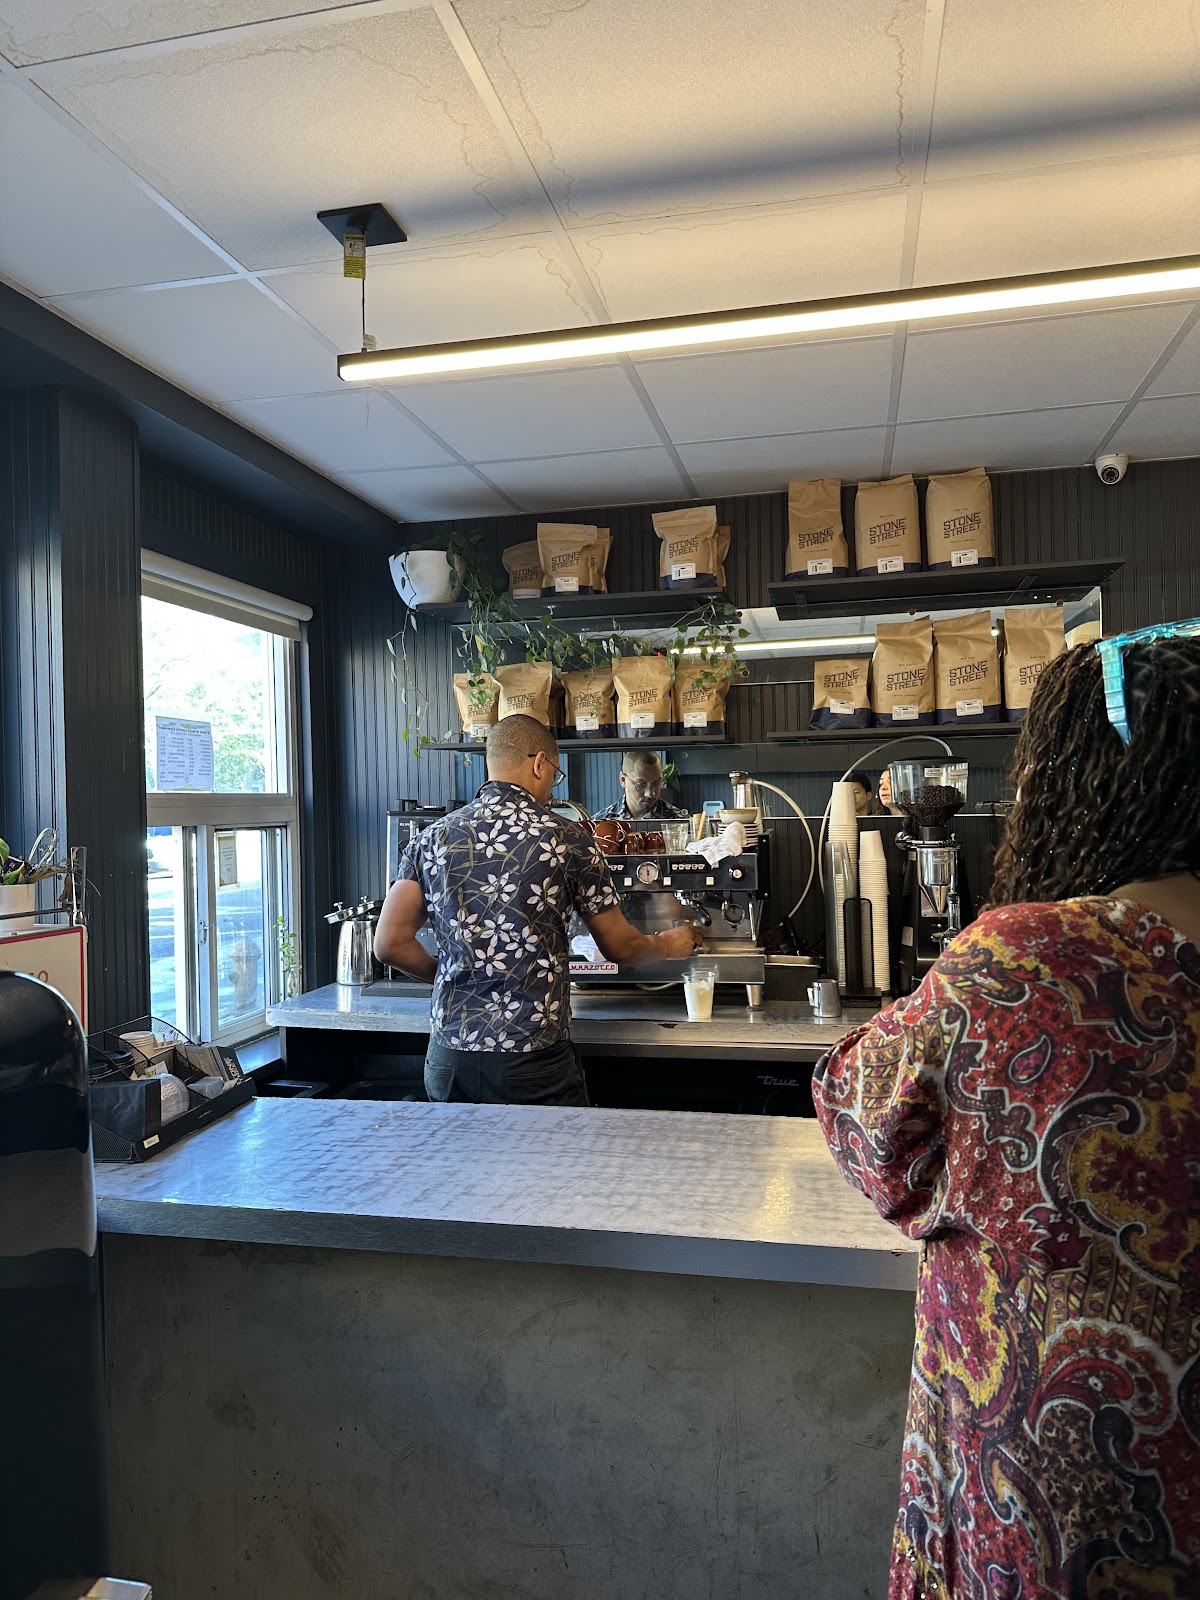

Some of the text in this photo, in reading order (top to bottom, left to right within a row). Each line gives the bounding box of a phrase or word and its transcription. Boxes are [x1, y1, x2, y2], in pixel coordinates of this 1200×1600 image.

[869, 517, 907, 537] STONE
[943, 511, 982, 531] STONE
[798, 526, 834, 542] STONE
[869, 527, 907, 545] STREET
[943, 521, 982, 539] STREET
[668, 536, 699, 552] STONE
[798, 534, 834, 549] STREET
[551, 551, 580, 565] STONE
[668, 544, 699, 559] STREET
[551, 558, 580, 572] STREET
[512, 566, 539, 579] STONE
[512, 574, 539, 585] STREET
[823, 668, 860, 682] STONE
[949, 660, 988, 679] STONE
[1019, 660, 1051, 677] STON
[823, 677, 859, 688] STREET
[886, 668, 926, 684] STONE
[949, 669, 988, 687] STREET
[1019, 673, 1039, 686] STR
[886, 678, 925, 692] STREET
[507, 692, 536, 705] STONE
[628, 687, 659, 701] STONE
[682, 695, 711, 707] STREET
[507, 701, 534, 712] STREET
[628, 695, 658, 708] STREET
[467, 708, 494, 719] STREET
